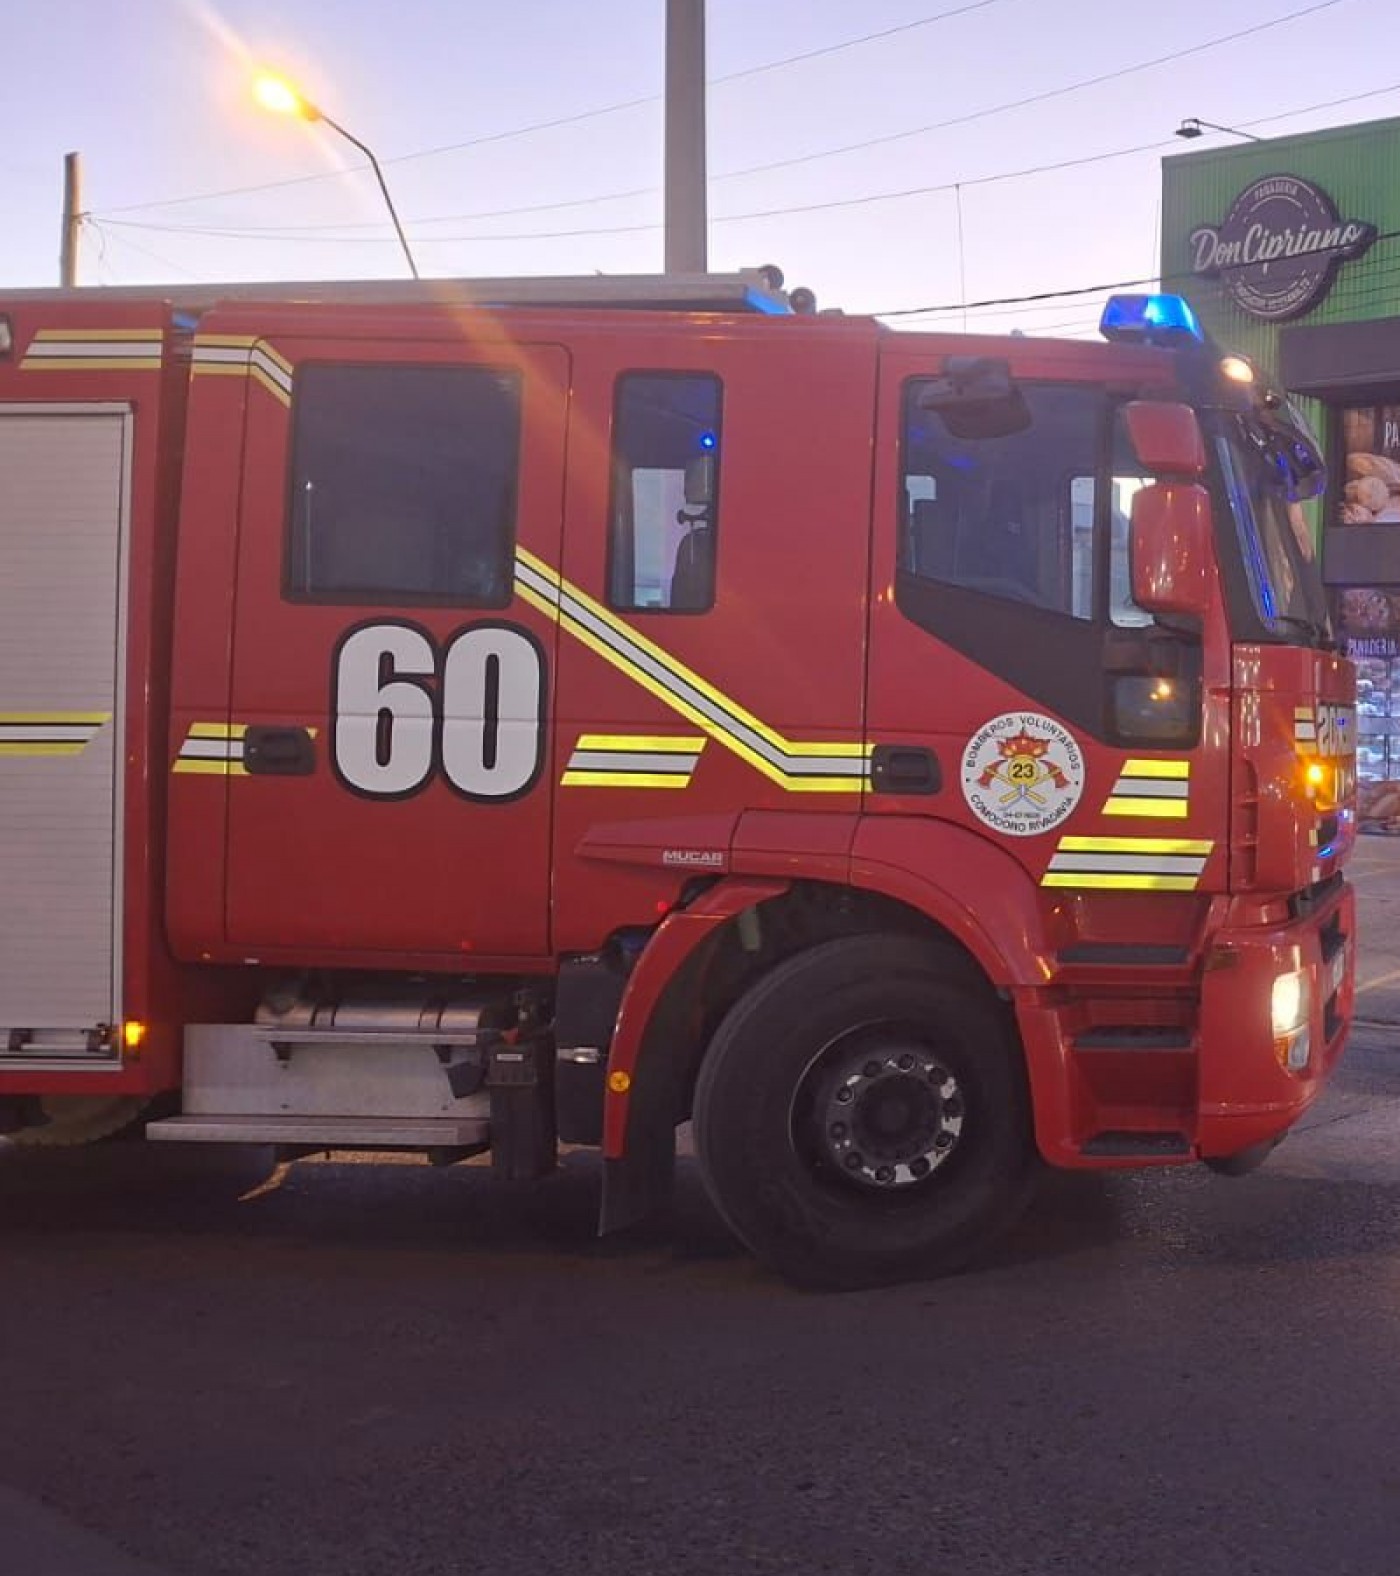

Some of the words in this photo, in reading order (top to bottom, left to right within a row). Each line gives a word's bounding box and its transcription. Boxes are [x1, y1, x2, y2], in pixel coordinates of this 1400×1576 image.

[1189, 227, 1242, 272] Don
[1242, 223, 1364, 274] Cipriano
[334, 624, 541, 796] 60
[965, 717, 1014, 768] BOMBEROS
[1018, 715, 1081, 770] VOLUNTARIOS
[1012, 762, 1035, 779] 23
[970, 794, 1027, 832] COMODORO
[662, 850, 723, 865] MUCAR
